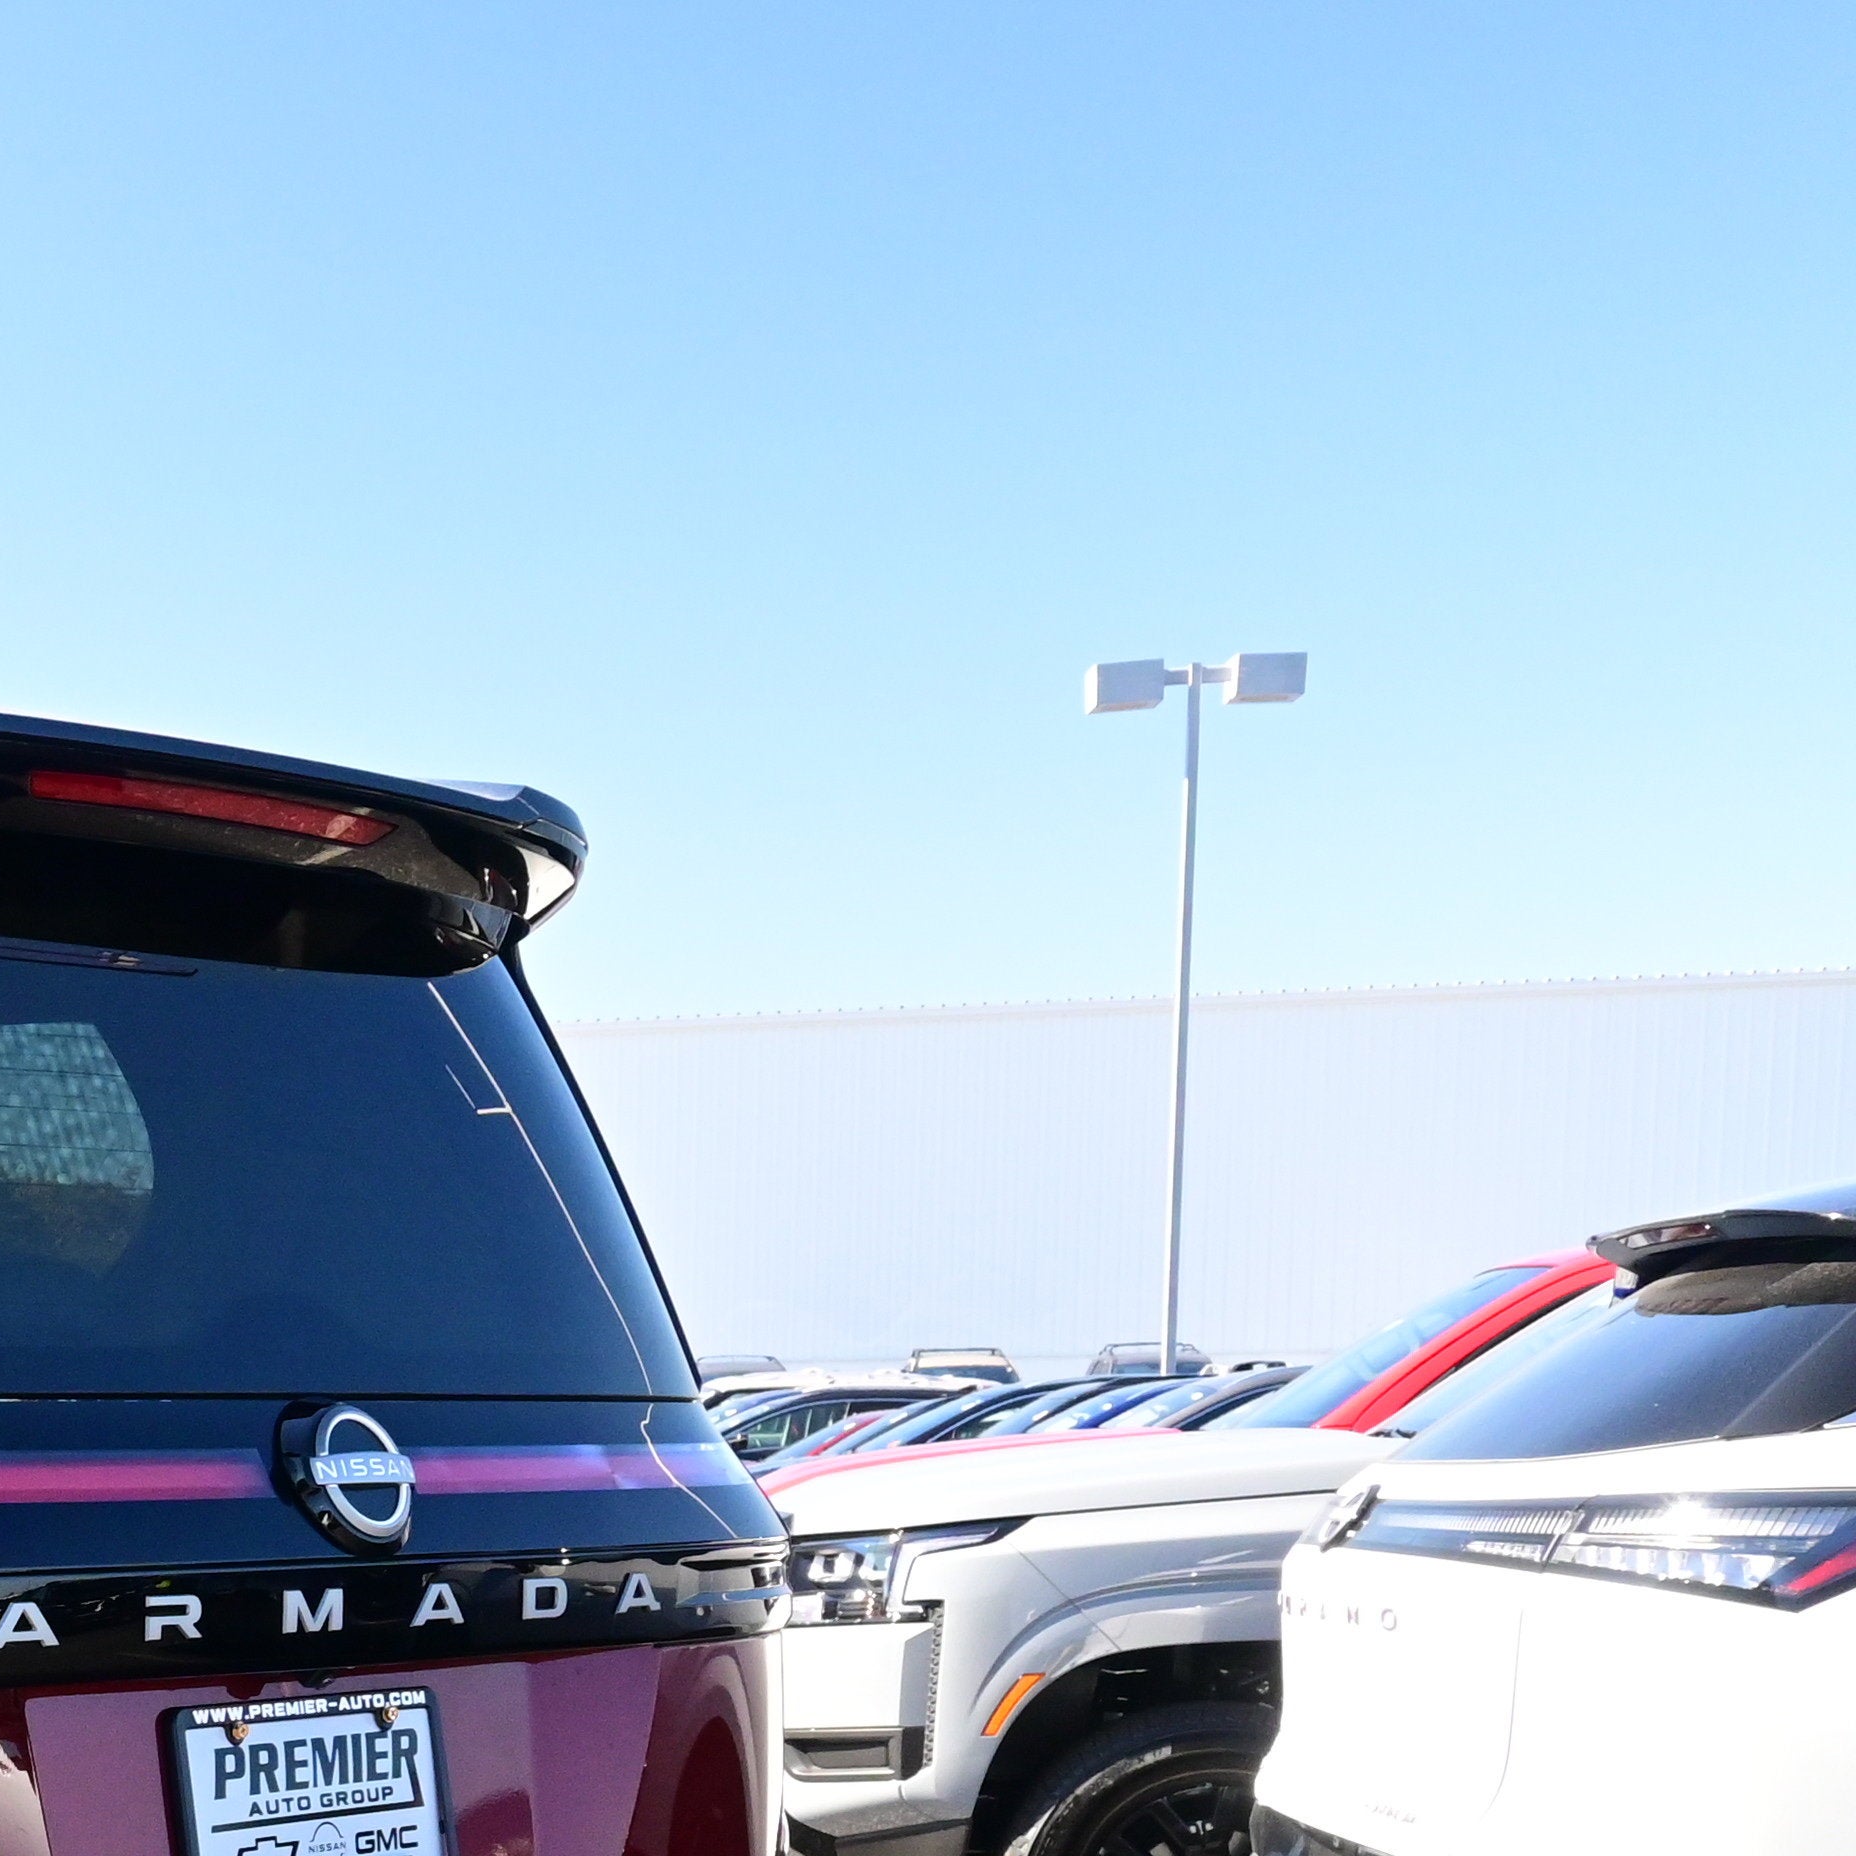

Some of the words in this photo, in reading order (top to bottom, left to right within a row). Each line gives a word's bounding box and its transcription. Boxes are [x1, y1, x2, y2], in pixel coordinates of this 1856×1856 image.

[314, 1453, 415, 1481] NISSAN
[192, 1690, 426, 1725] WWW.PREMIER-AUTO.COM
[213, 1727, 421, 1801] PREMIER
[248, 1794, 312, 1818] AUTO
[319, 1785, 395, 1809] GROUP
[307, 1839, 347, 1854] NISSAN
[354, 1824, 419, 1855] GMC
